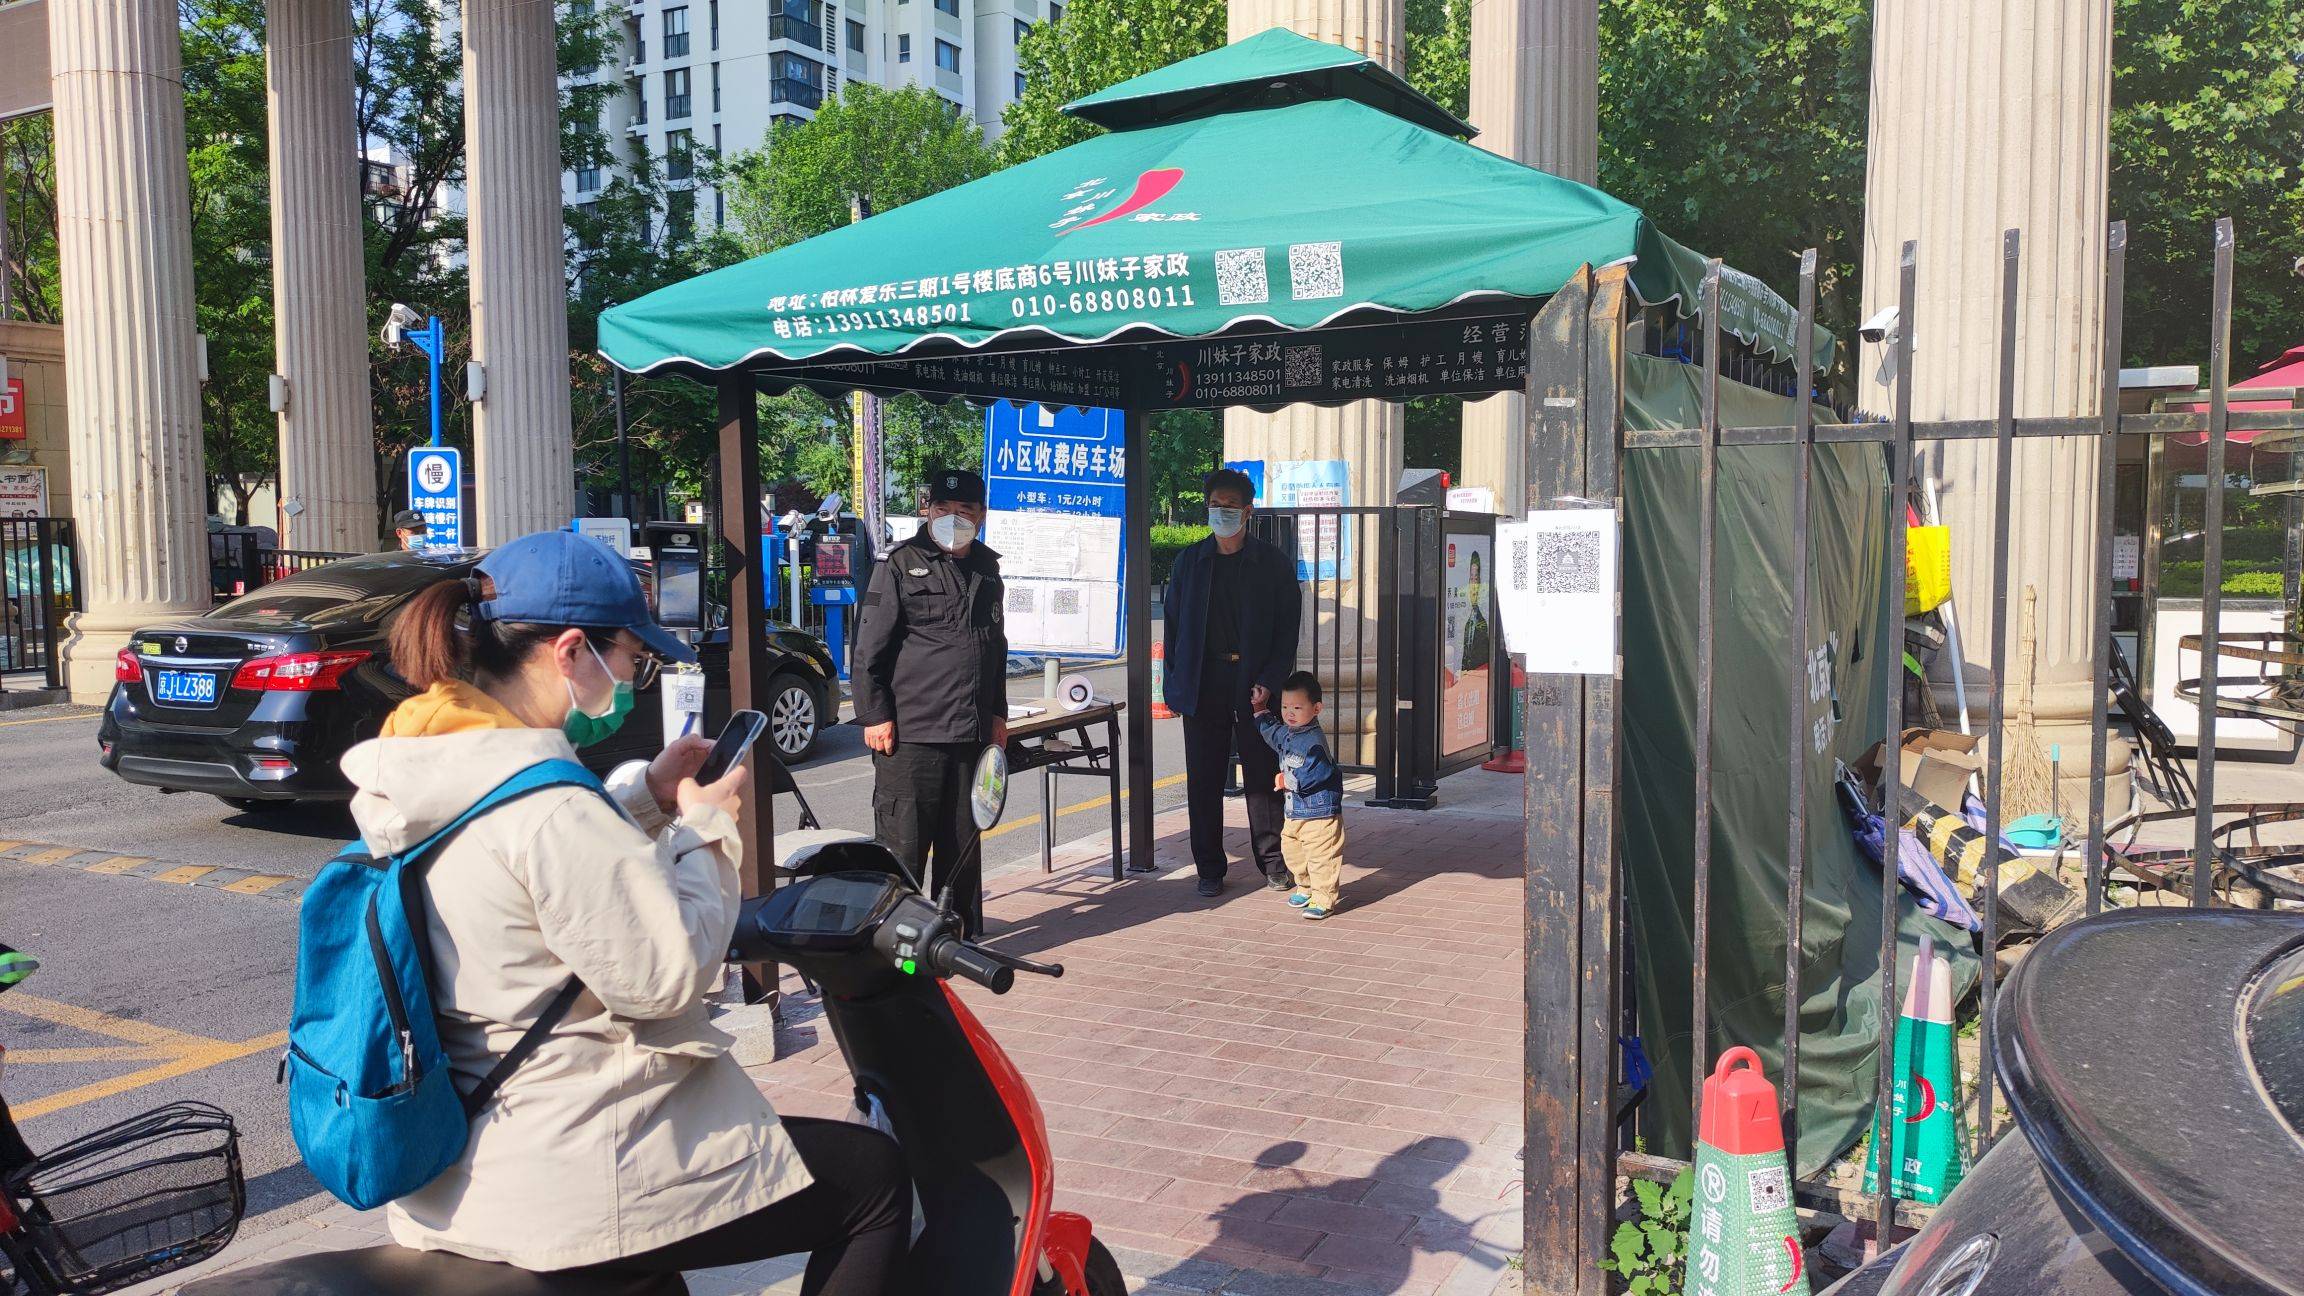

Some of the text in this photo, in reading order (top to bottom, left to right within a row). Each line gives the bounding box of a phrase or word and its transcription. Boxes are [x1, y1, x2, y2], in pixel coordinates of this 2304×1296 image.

[1011, 284, 1195, 318] 010-68808011
[1197, 341, 1283, 367] 川妹子家政
[1331, 358, 1374, 373] 家政服务
[1382, 356, 1409, 370] 保姆
[1420, 354, 1447, 368] 护工
[1196, 368, 1281, 385] 13911348501
[1331, 375, 1373, 391] 家电清洗
[1384, 372, 1430, 387] 洗油烟机
[1440, 369, 1486, 385] 单位保洁
[1195, 384, 1281, 399] 010-68808011
[997, 439, 1125, 479] 小区收费停车场
[425, 463, 444, 485] 慢
